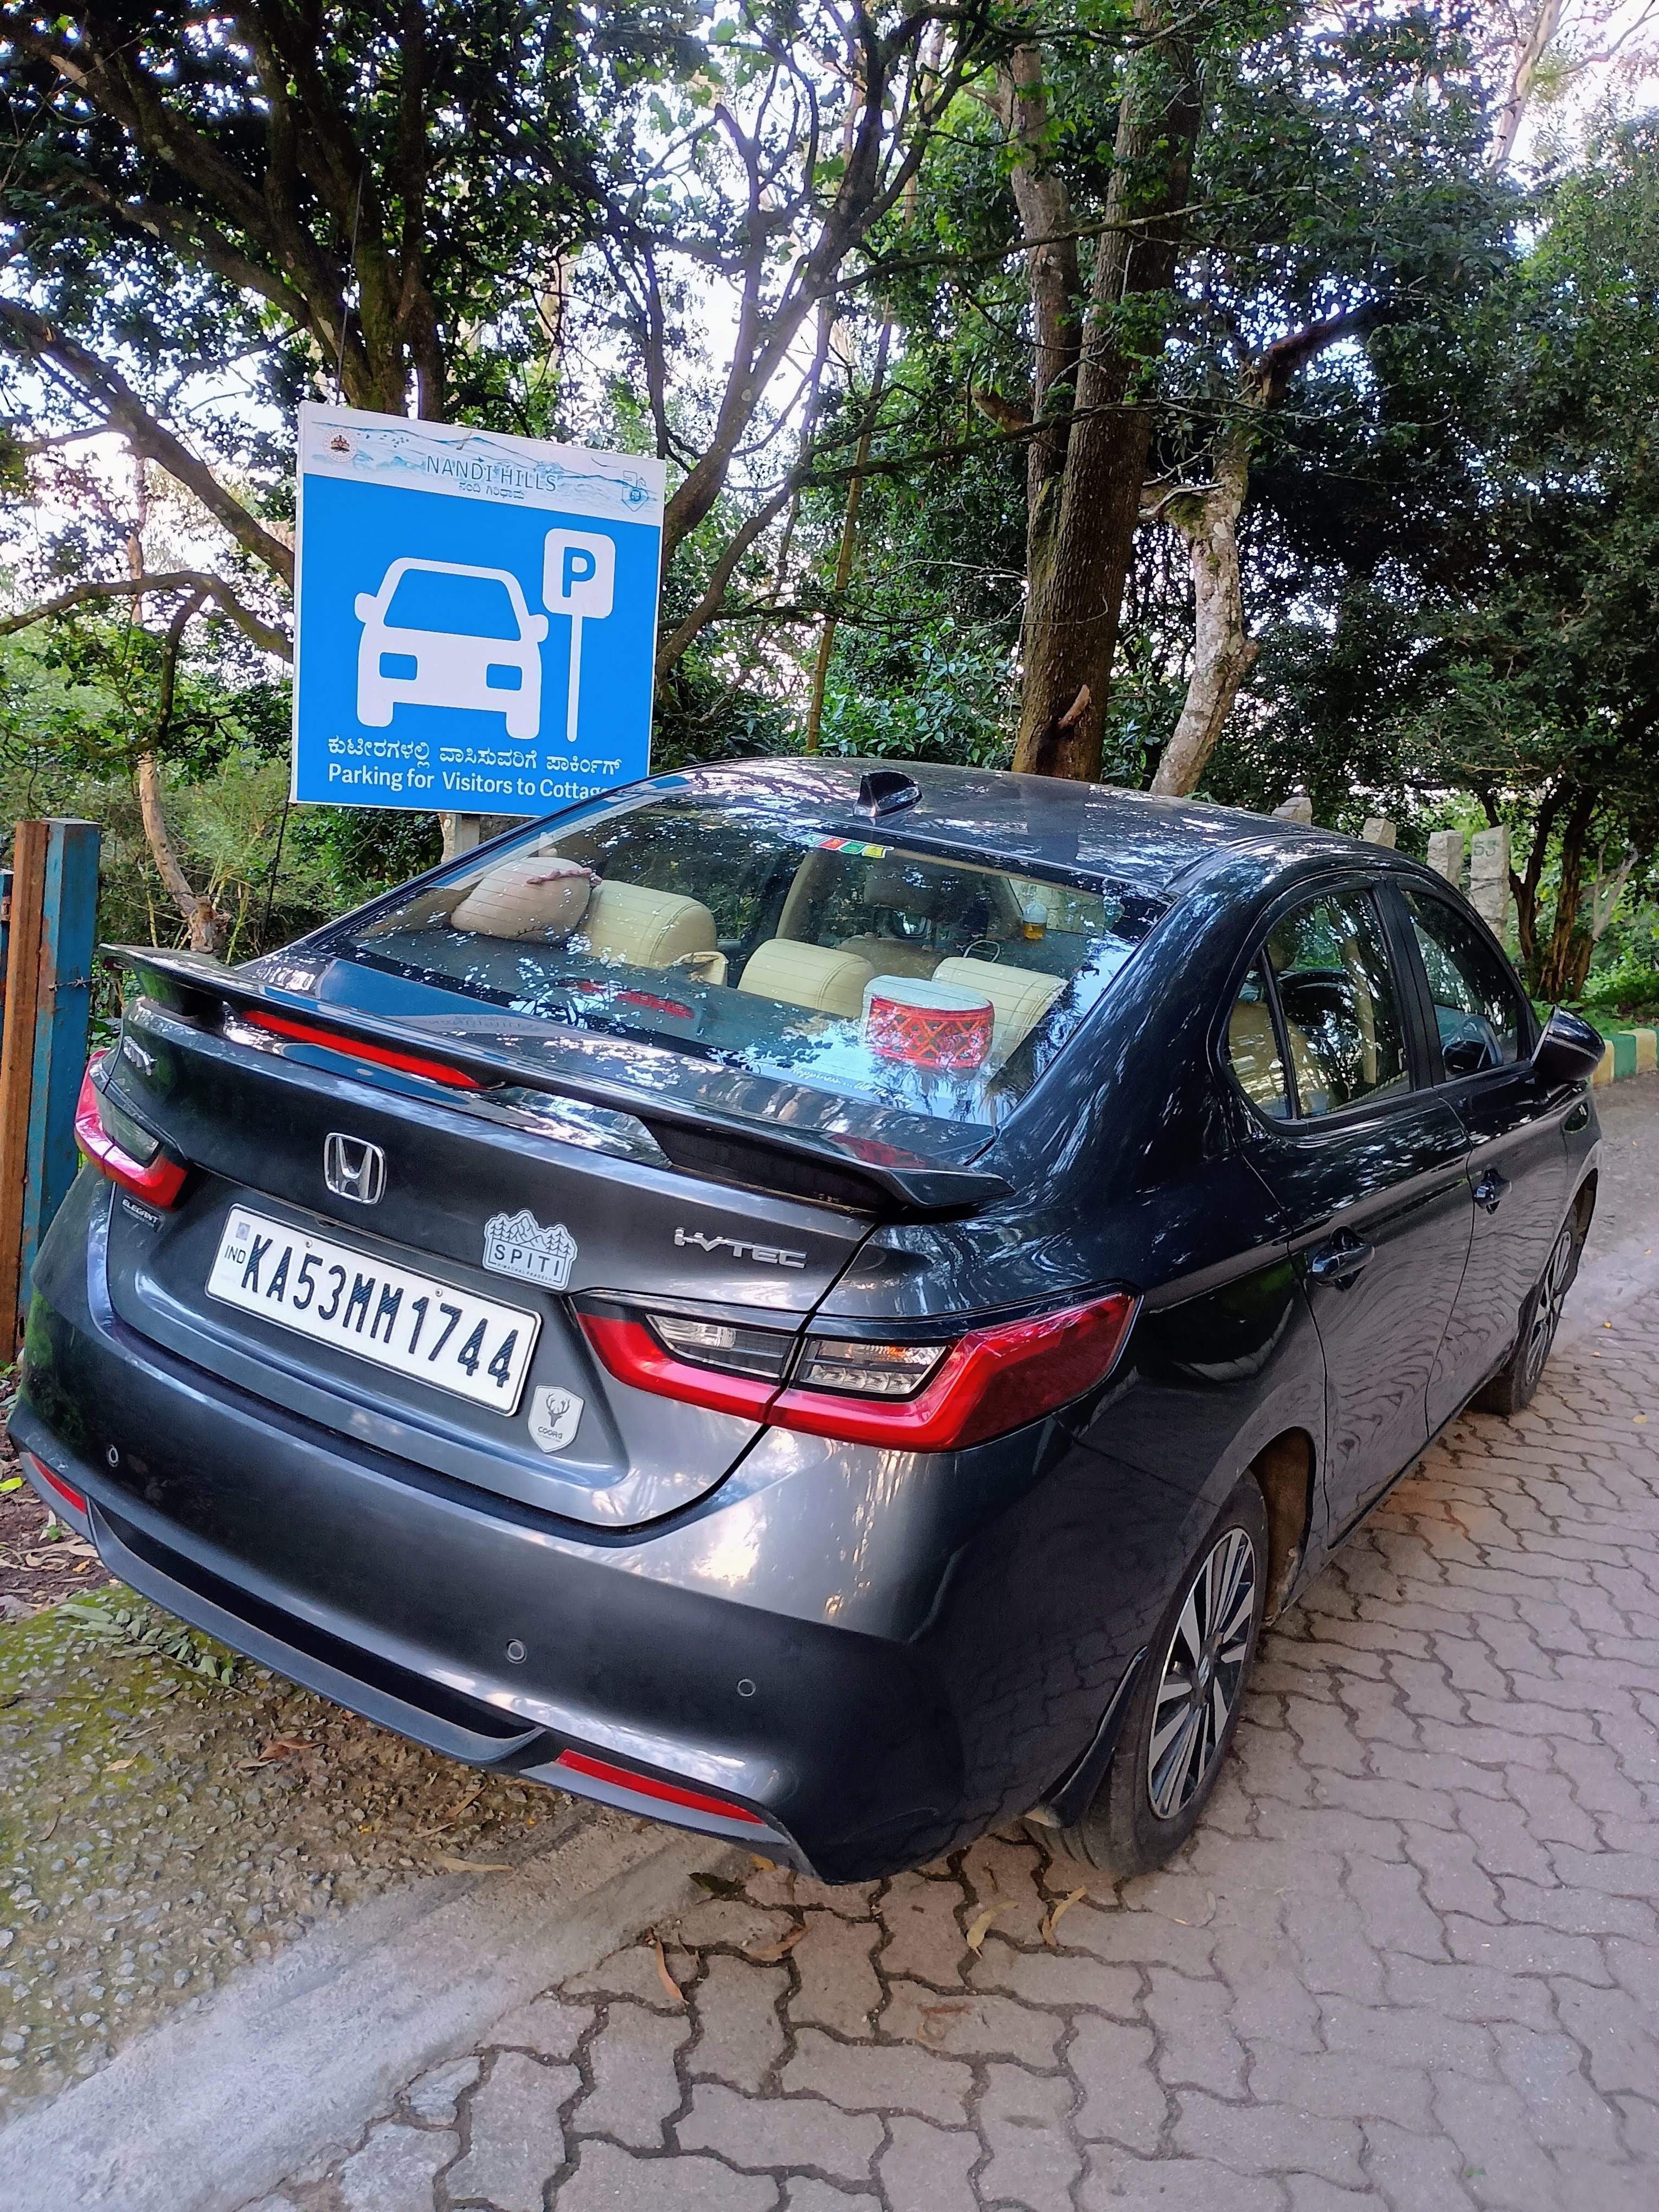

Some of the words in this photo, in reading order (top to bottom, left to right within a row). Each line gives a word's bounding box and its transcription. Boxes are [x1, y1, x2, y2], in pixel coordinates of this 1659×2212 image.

[427, 455, 493, 482] NANDI
[501, 467, 557, 492] HILLS
[562, 546, 596, 598] P
[328, 735, 430, 769] ಕುಟೀರಗಳಲ್ಲಿ
[439, 746, 538, 769] ವಾಸಿಸುವರಿಗೆ
[328, 763, 403, 792] Parking
[407, 768, 435, 789] for
[442, 771, 513, 795] Visitors
[517, 777, 536, 796] to
[224, 1244, 246, 1264] IND
[494, 1244, 560, 1277] SPITI
[240, 1233, 519, 1388] KA53MM1744
